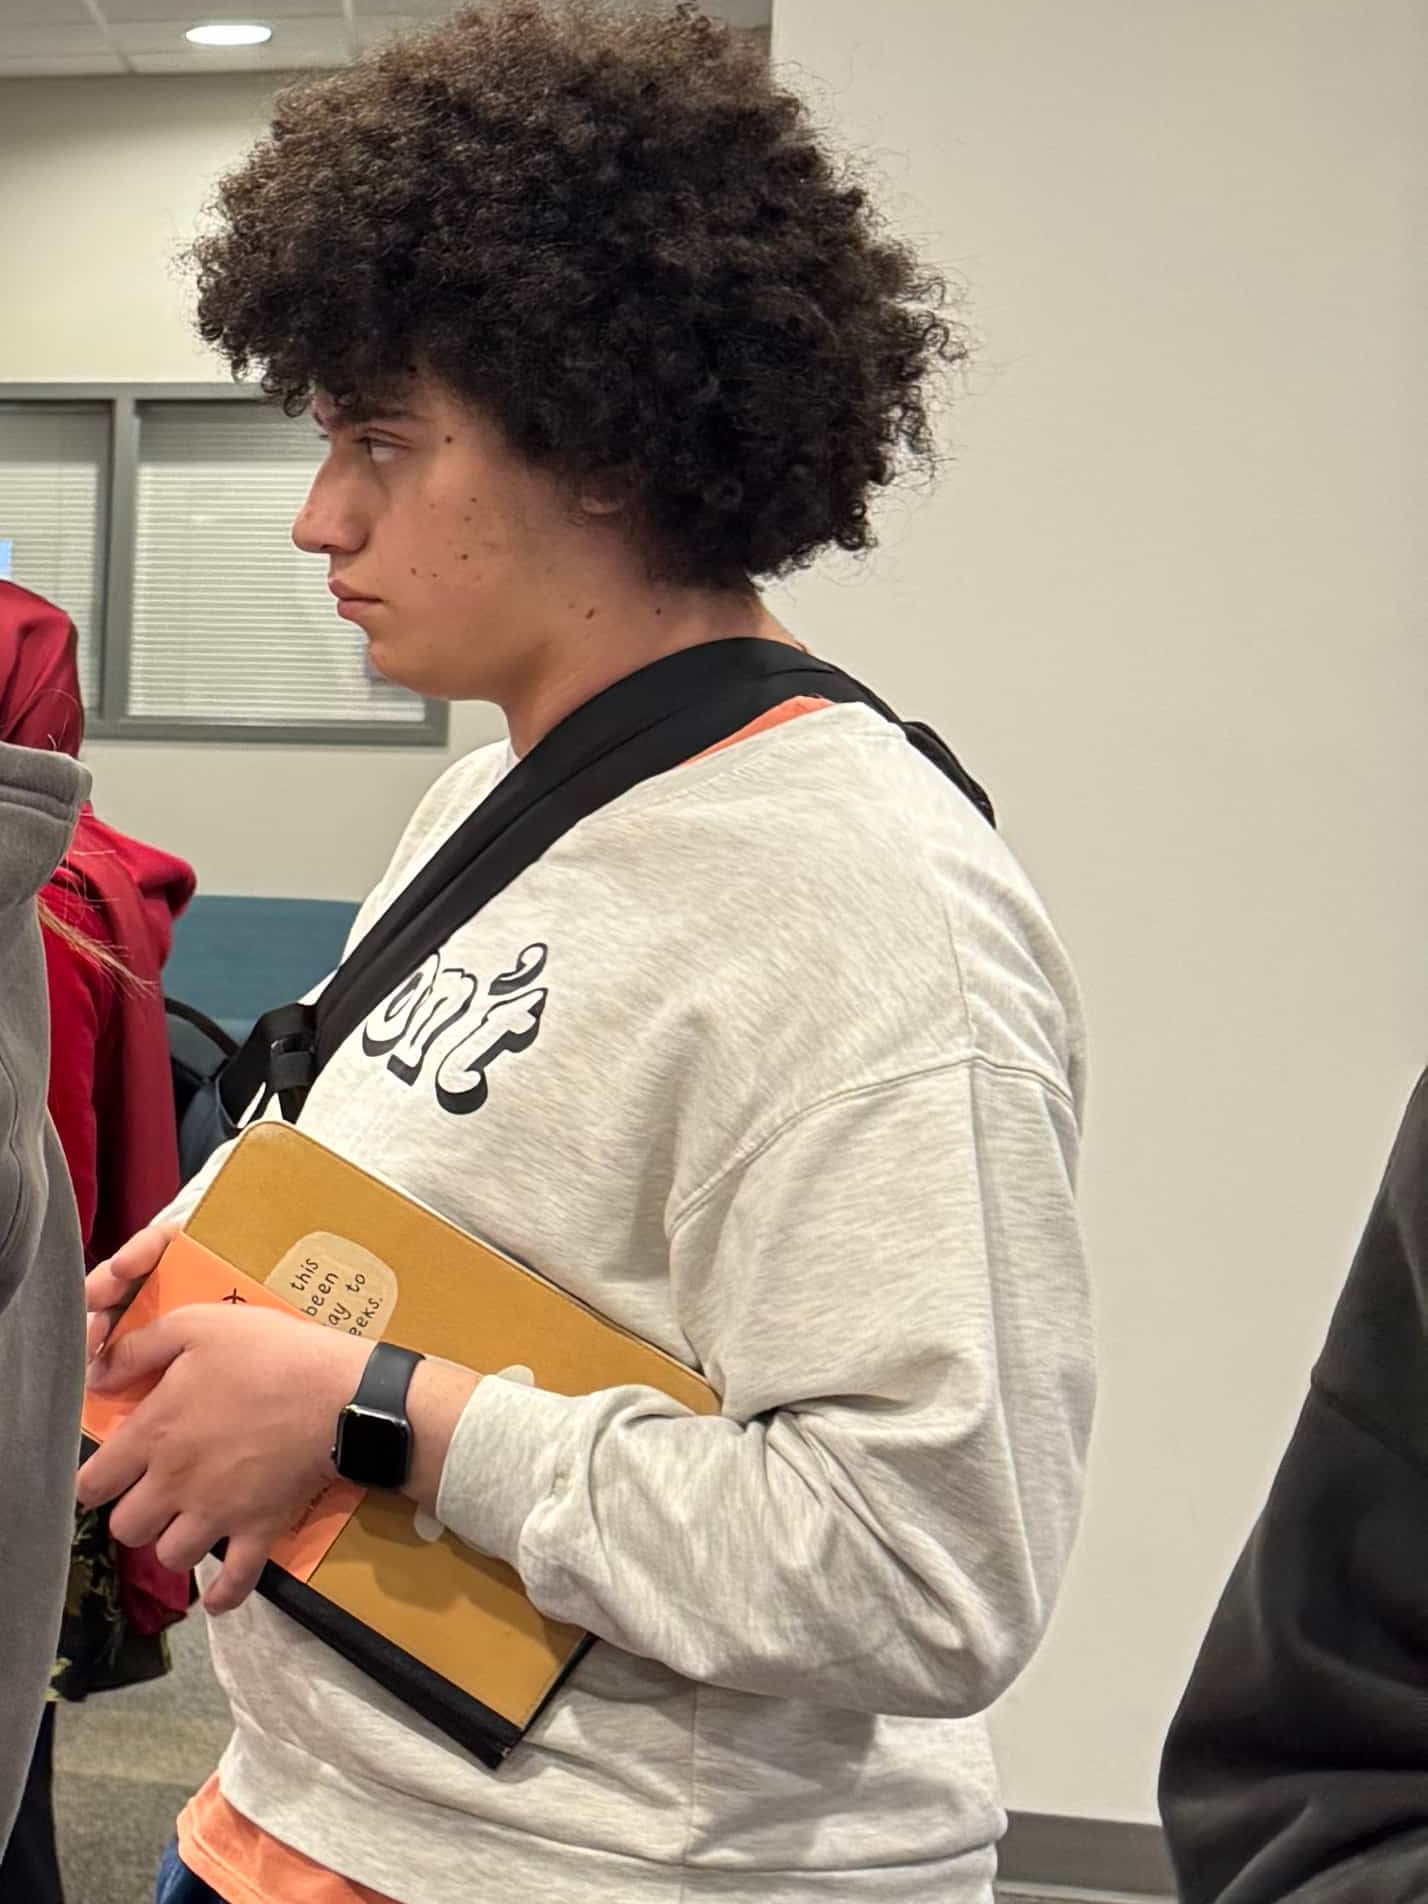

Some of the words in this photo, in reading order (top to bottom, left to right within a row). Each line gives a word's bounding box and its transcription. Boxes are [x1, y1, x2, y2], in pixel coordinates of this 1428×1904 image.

[362, 942, 549, 1115] on't
[290, 1258, 320, 1291] this
[302, 1272, 339, 1317] been
[328, 1302, 352, 1326] ay
[346, 1274, 366, 1293] to
[349, 1297, 384, 1336] eeks.
